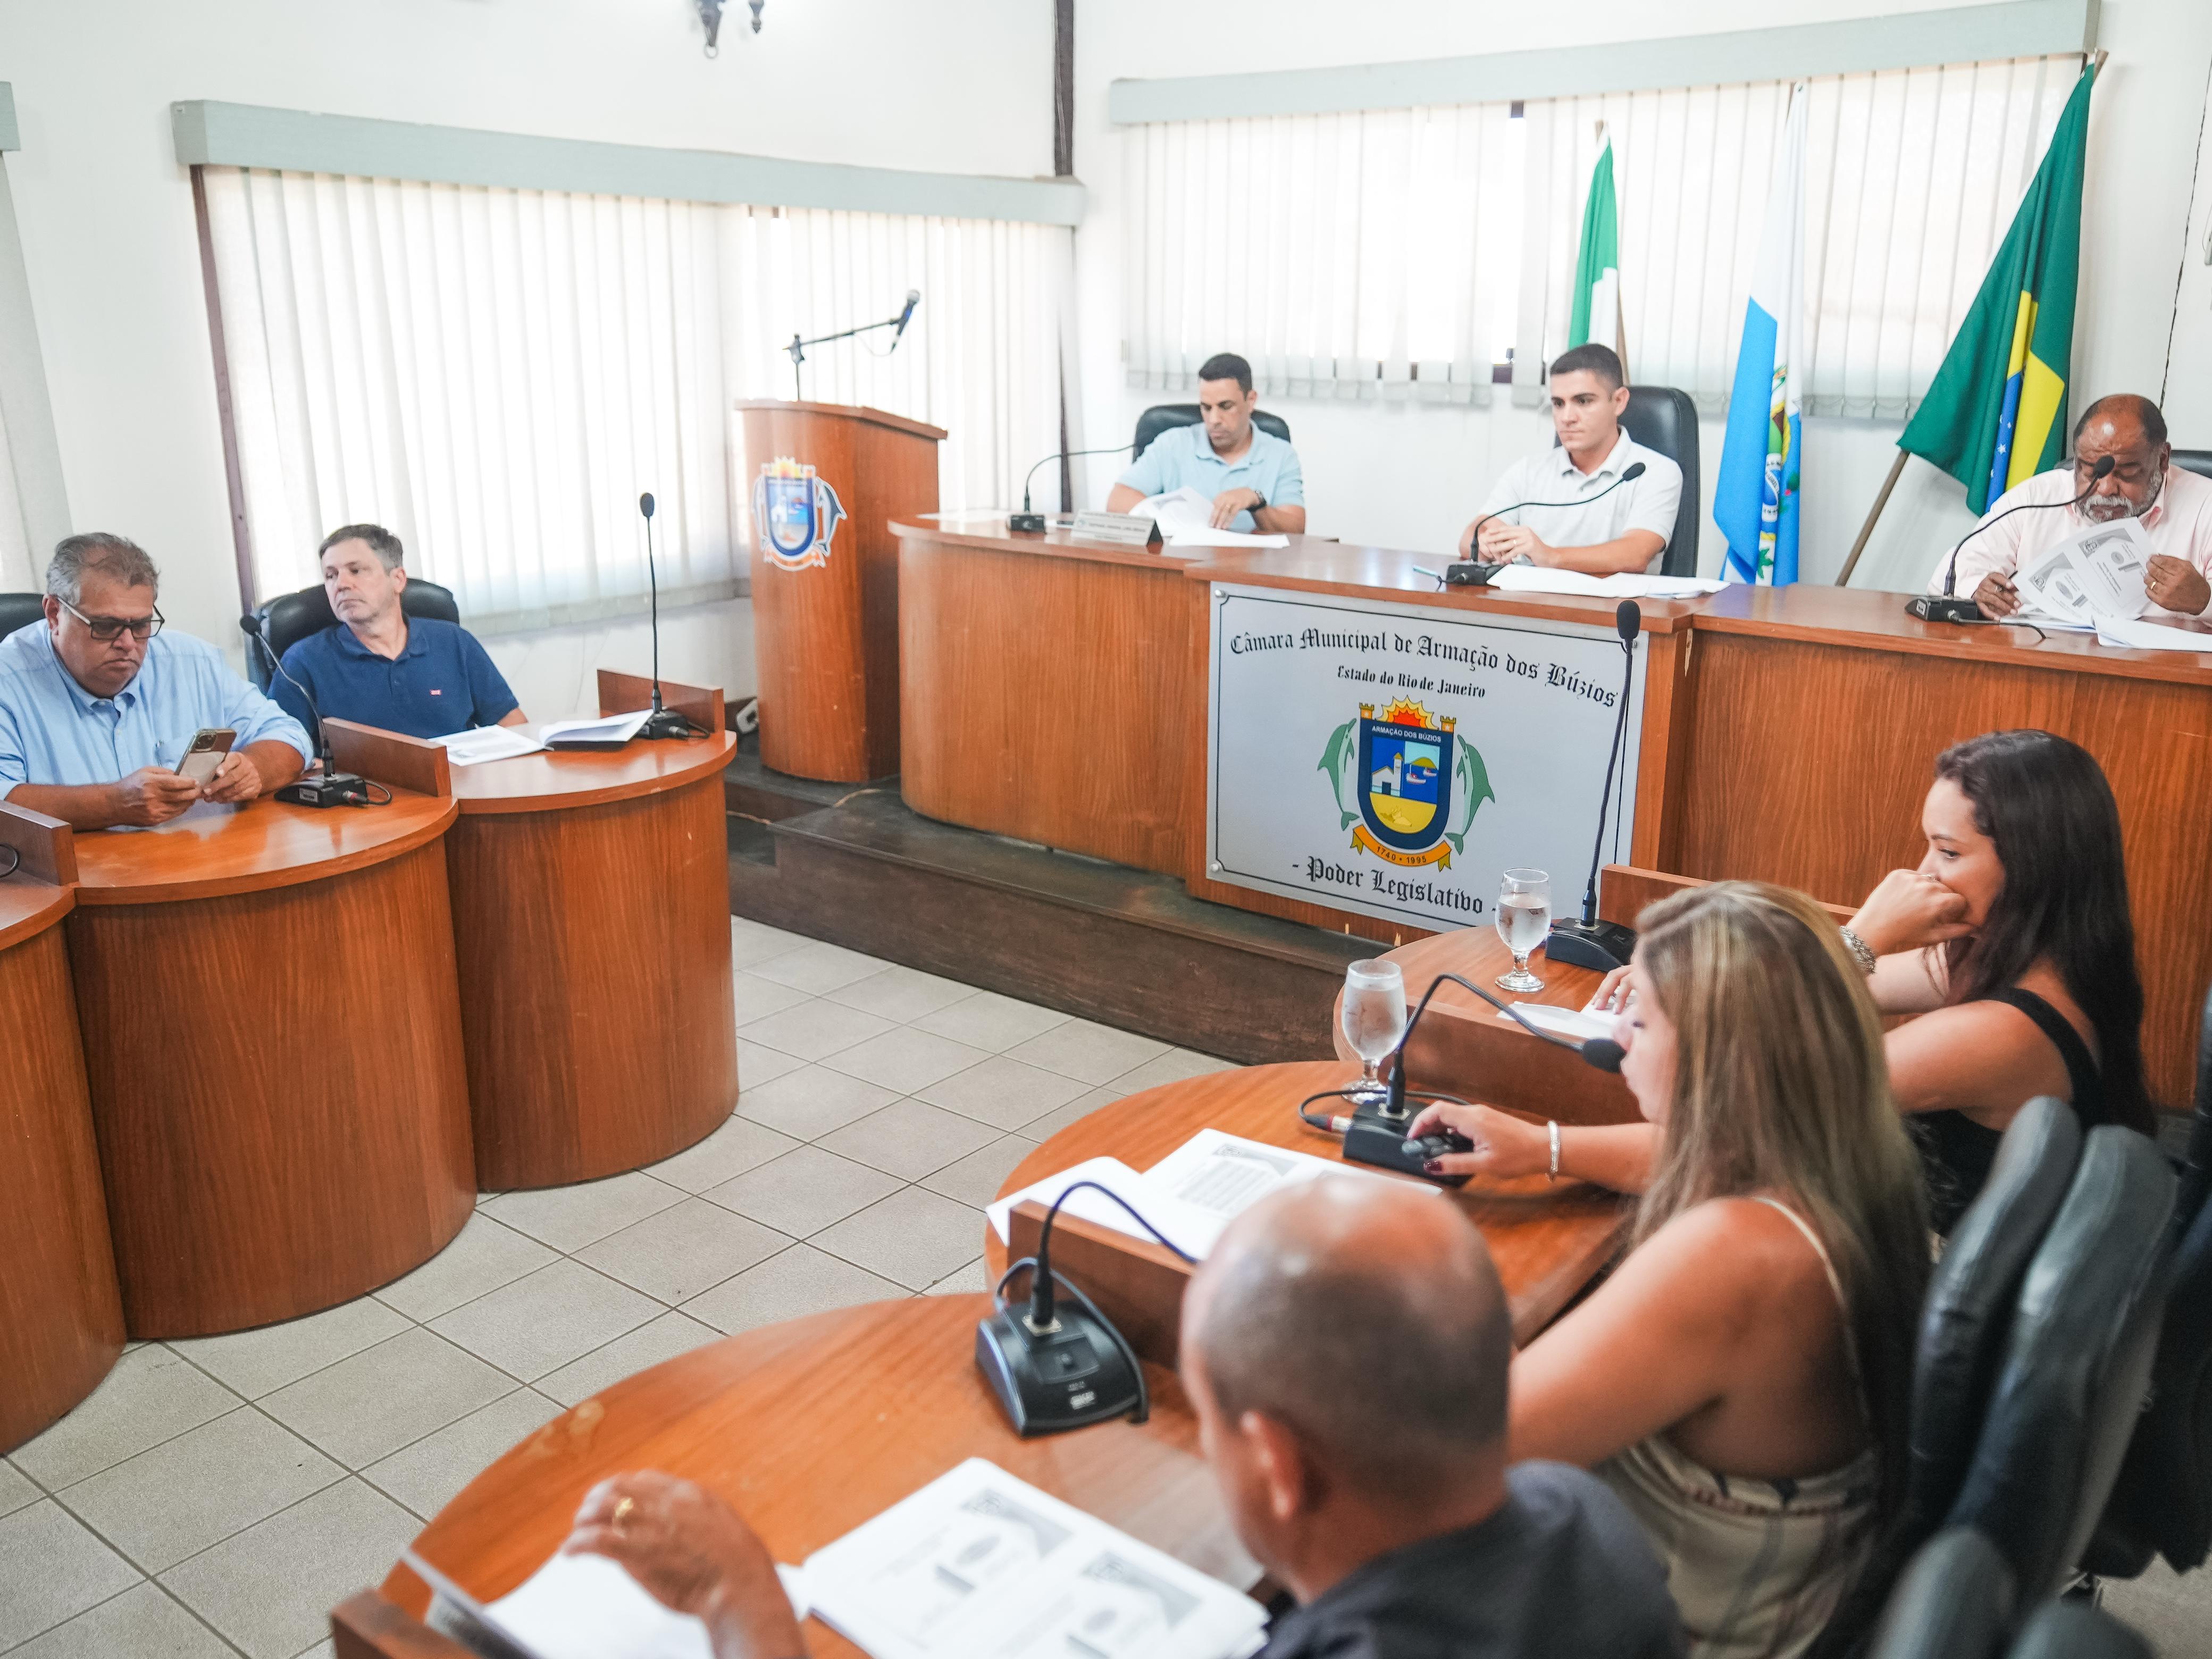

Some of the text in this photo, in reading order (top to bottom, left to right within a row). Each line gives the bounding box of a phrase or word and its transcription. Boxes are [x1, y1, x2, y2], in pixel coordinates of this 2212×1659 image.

[1230, 627, 1619, 708] Câmara Municipal de Armação dos Búzios
[1337, 665, 1376, 683] Estado
[1379, 671, 1394, 685] do
[1437, 678, 1486, 698] Janeiro
[1371, 725, 1442, 743] ARMAÇÃO DOS BÚZIOS
[1377, 846, 1427, 864] 1740 1995
[1306, 856, 1363, 887] Poder
[1370, 868, 1483, 914] Legislativo
